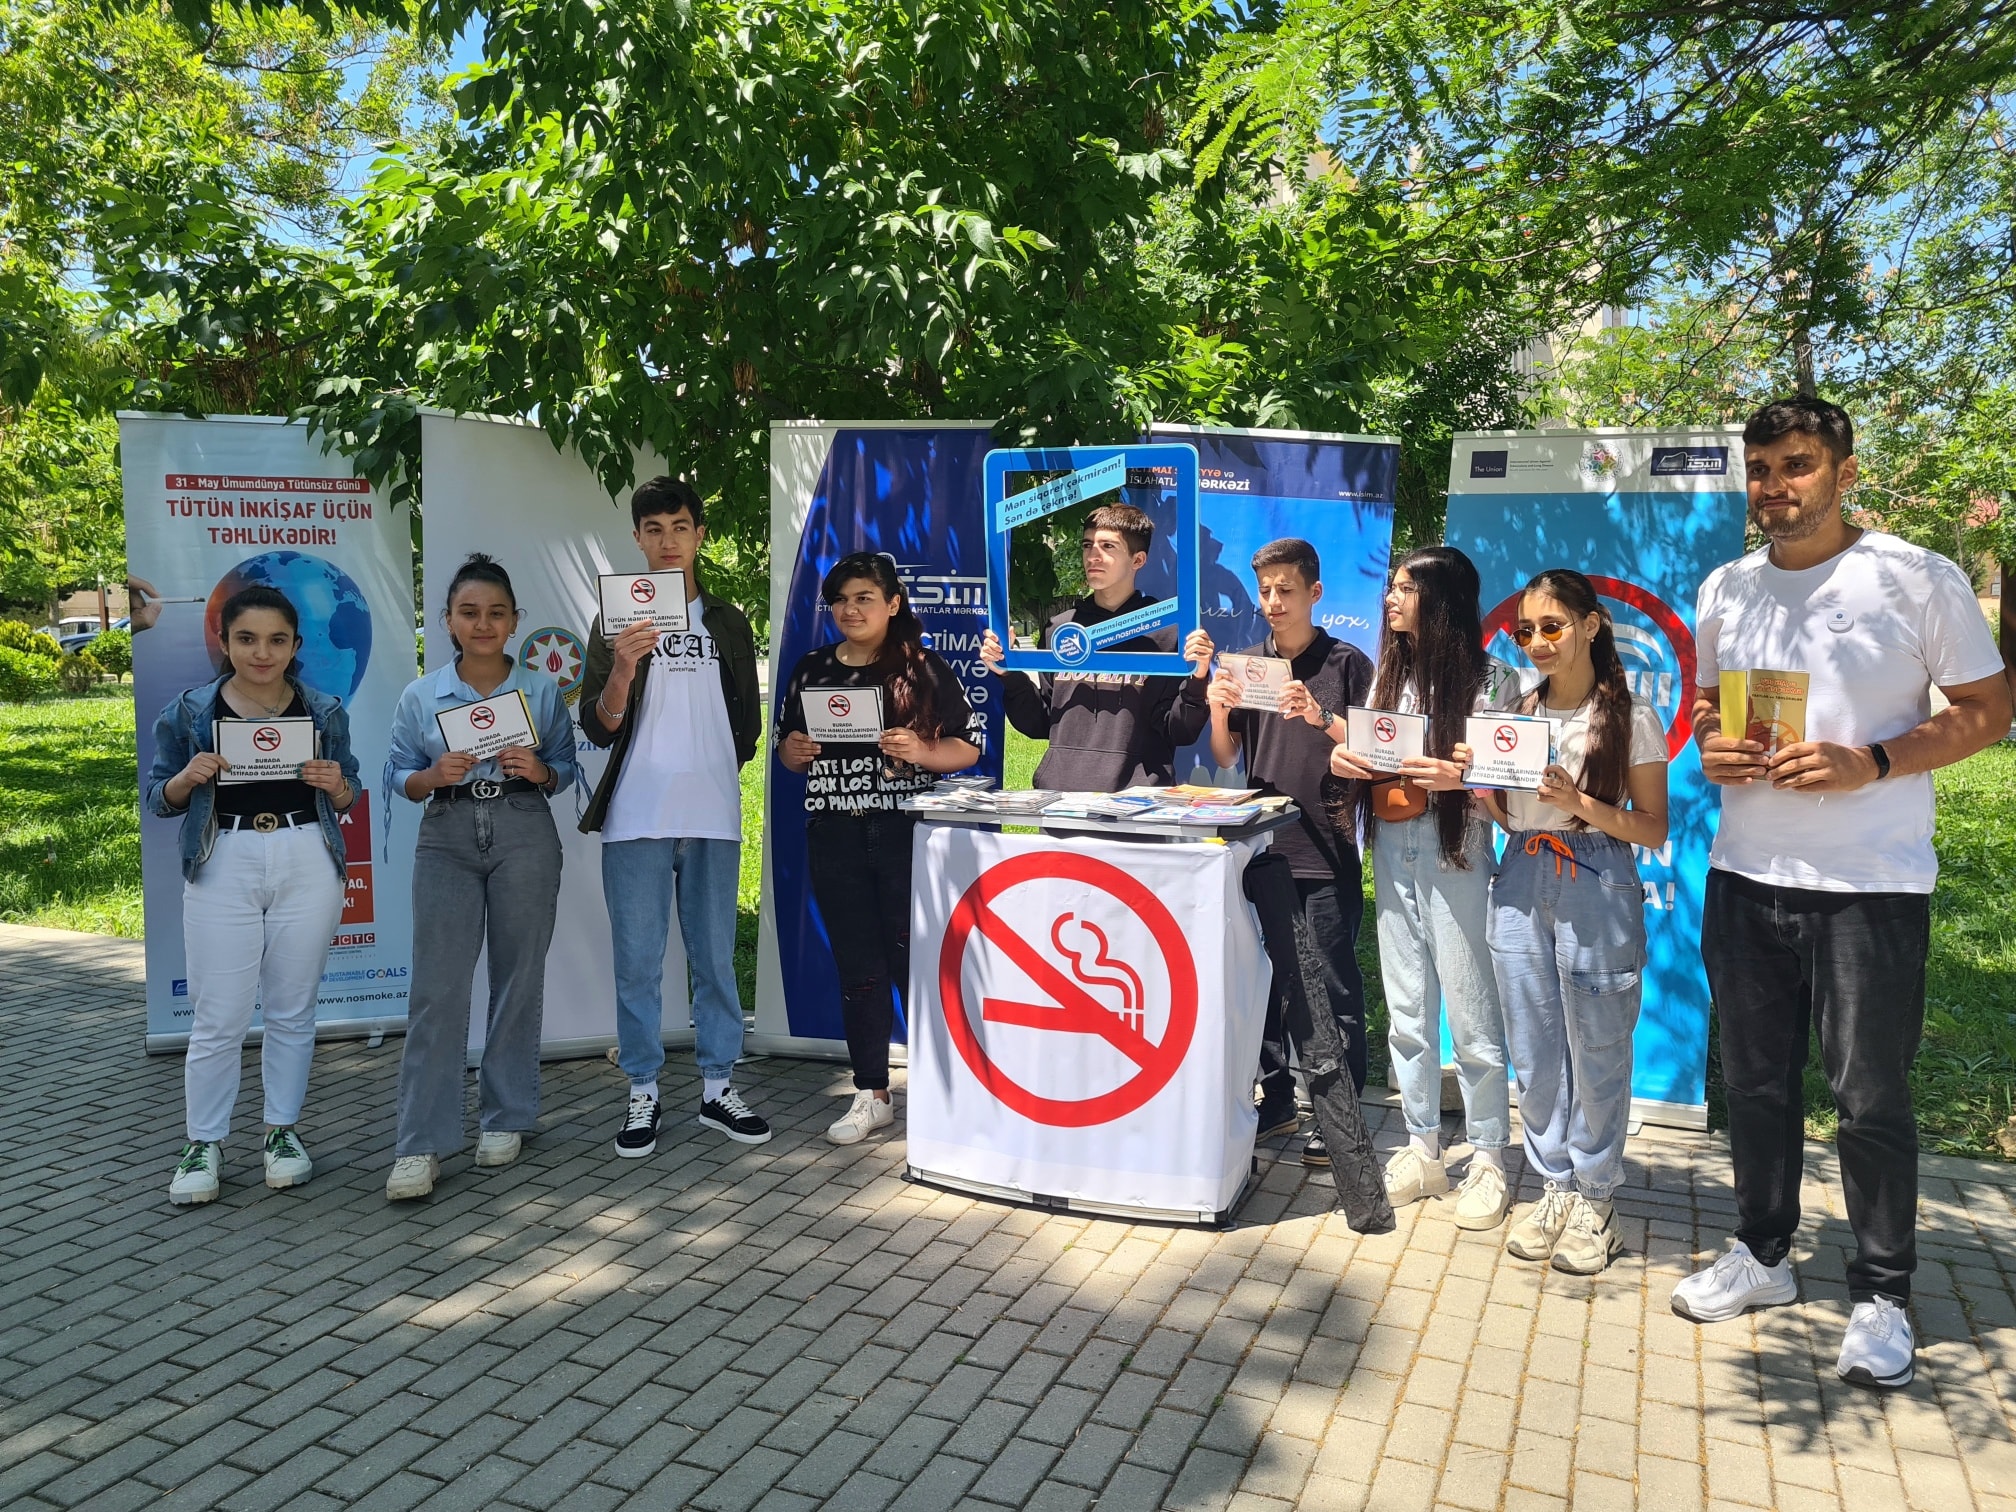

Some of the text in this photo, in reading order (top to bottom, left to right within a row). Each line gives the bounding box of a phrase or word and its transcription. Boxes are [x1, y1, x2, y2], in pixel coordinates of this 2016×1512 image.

[175, 477, 188, 488] 31
[198, 478, 219, 490] May
[222, 476, 285, 490] Ümumdünya
[287, 479, 333, 490] Tütünsüz
[336, 480, 361, 491] Günü
[1004, 498, 1026, 513] Mən
[1066, 458, 1121, 490] çəkmirəm!
[1130, 474, 1250, 491] İSLAHATL ƏRKƏZİ
[1338, 490, 1384, 499] www.isim.az
[166, 496, 373, 522] TÜTÜN İNKİŞAF ÜÇÜN
[1004, 489, 1078, 526] Sən də çəkmə!
[207, 524, 337, 545] TƏHLÜKƏDİR!
[911, 606, 951, 615] AHATLAR
[953, 607, 989, 616] MƏRKƏZ
[1321, 611, 1370, 630] yox,
[920, 629, 982, 652] CTİMA
[1095, 619, 1162, 647] www.nosmoke.az
[842, 756, 874, 775] LOS
[840, 774, 872, 793] LOS
[366, 966, 407, 980] GOALS
[317, 991, 408, 1005] www.nosmoke.az
